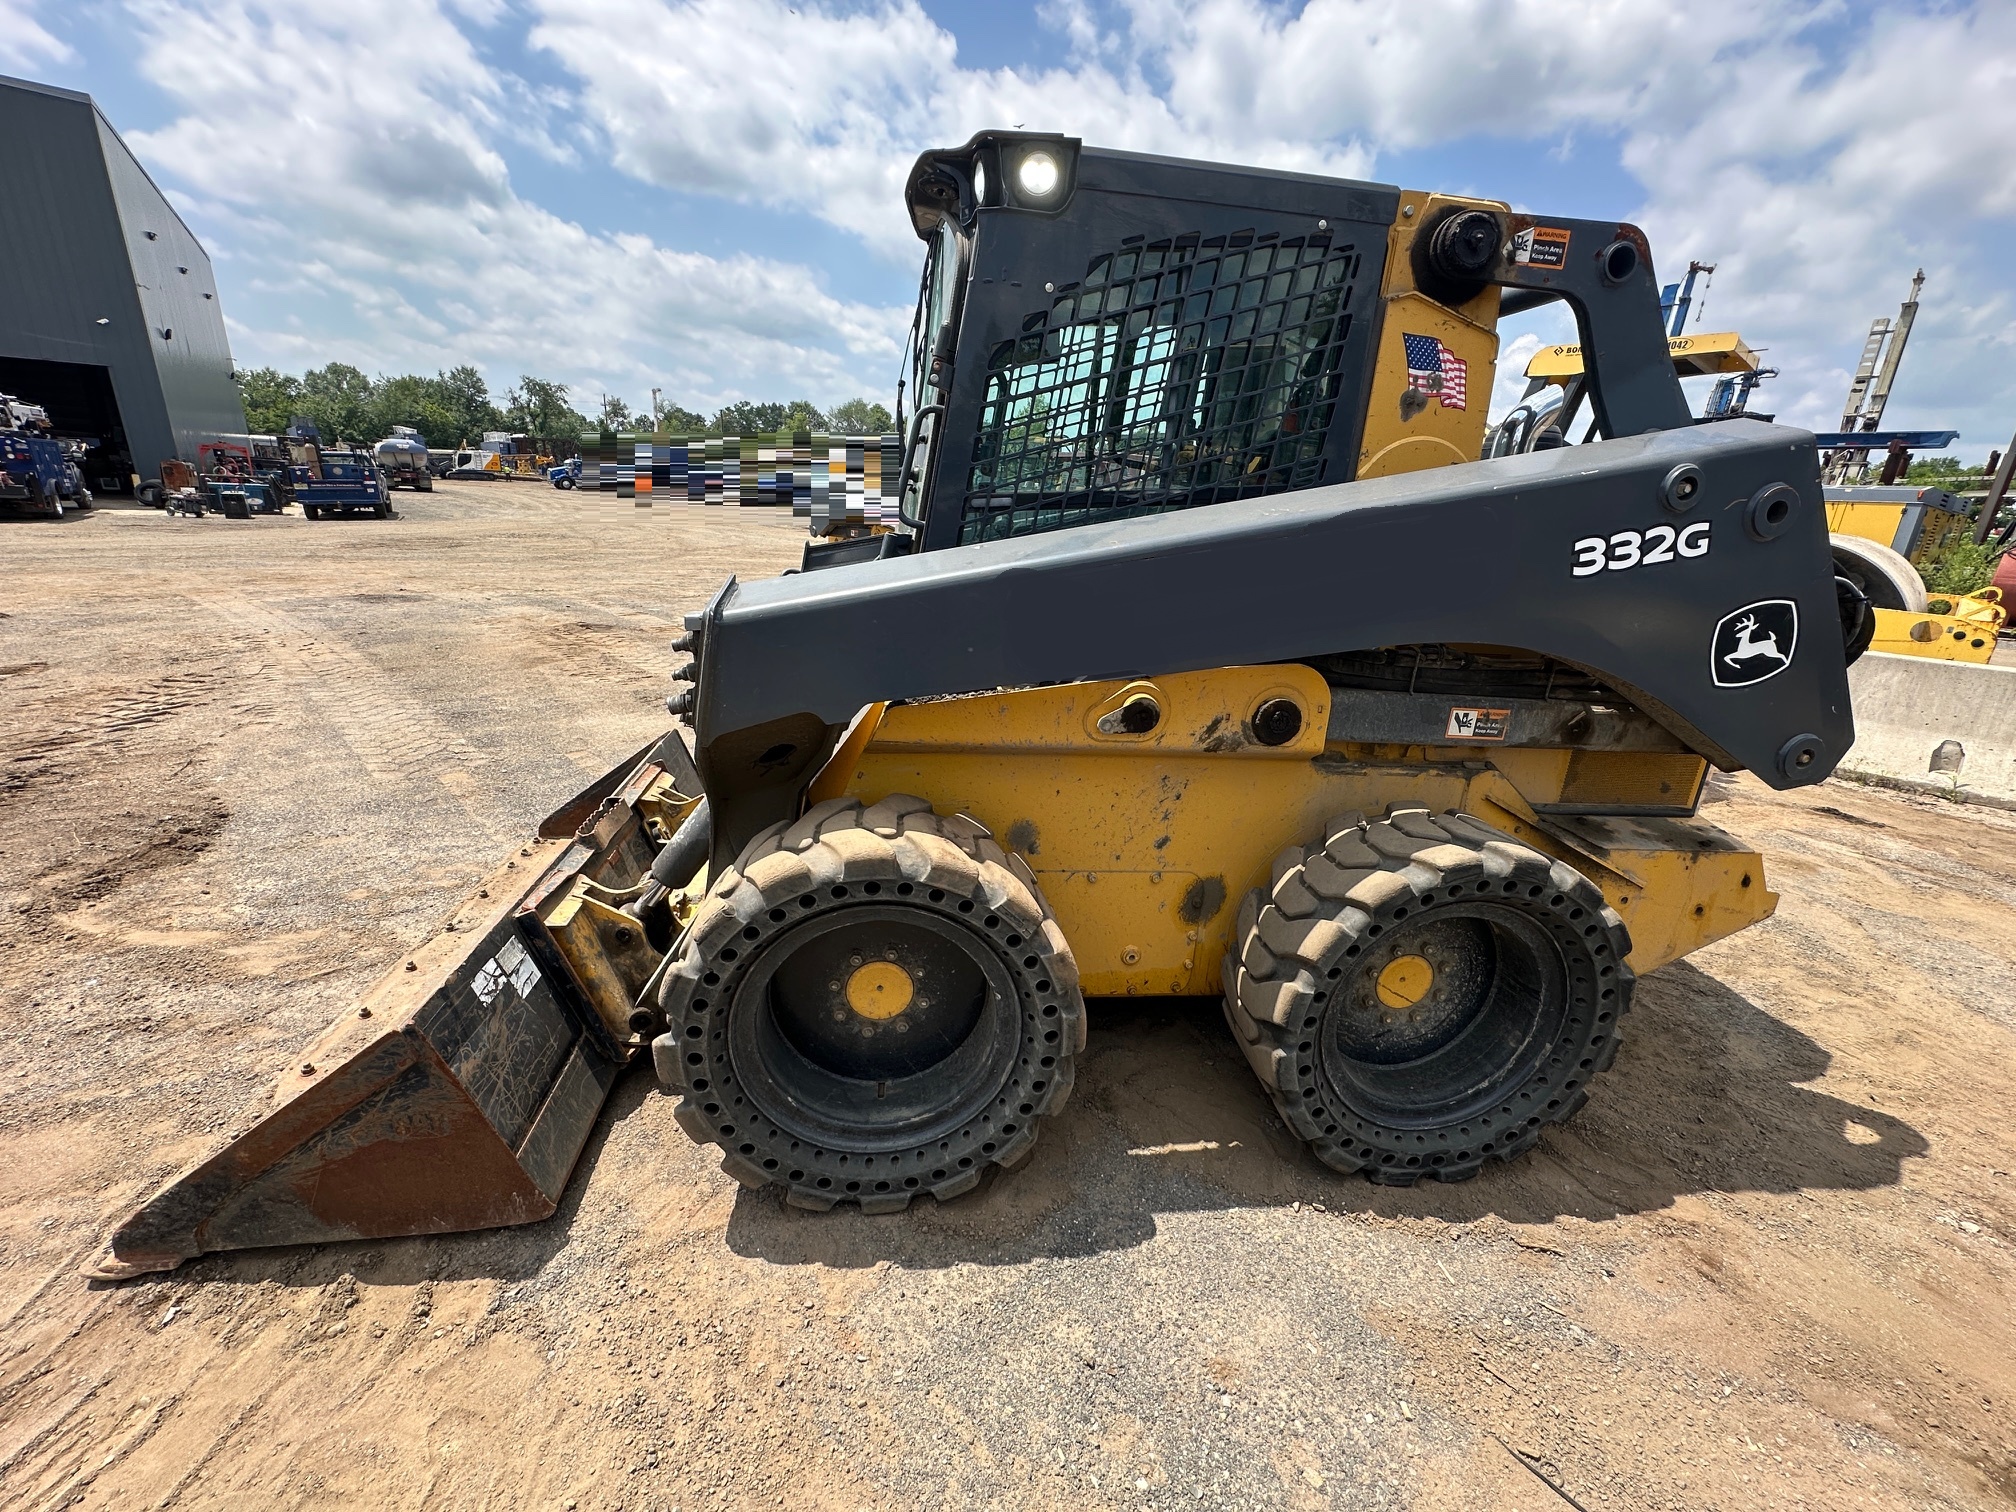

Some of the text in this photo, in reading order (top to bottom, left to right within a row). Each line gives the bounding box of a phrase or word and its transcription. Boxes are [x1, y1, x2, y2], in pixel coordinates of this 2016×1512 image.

[1542, 231, 1567, 239] WARNING
[1533, 244, 1563, 254] Pinch Area
[1532, 252, 1558, 262] Keep Away
[1572, 521, 1711, 577] 332G
